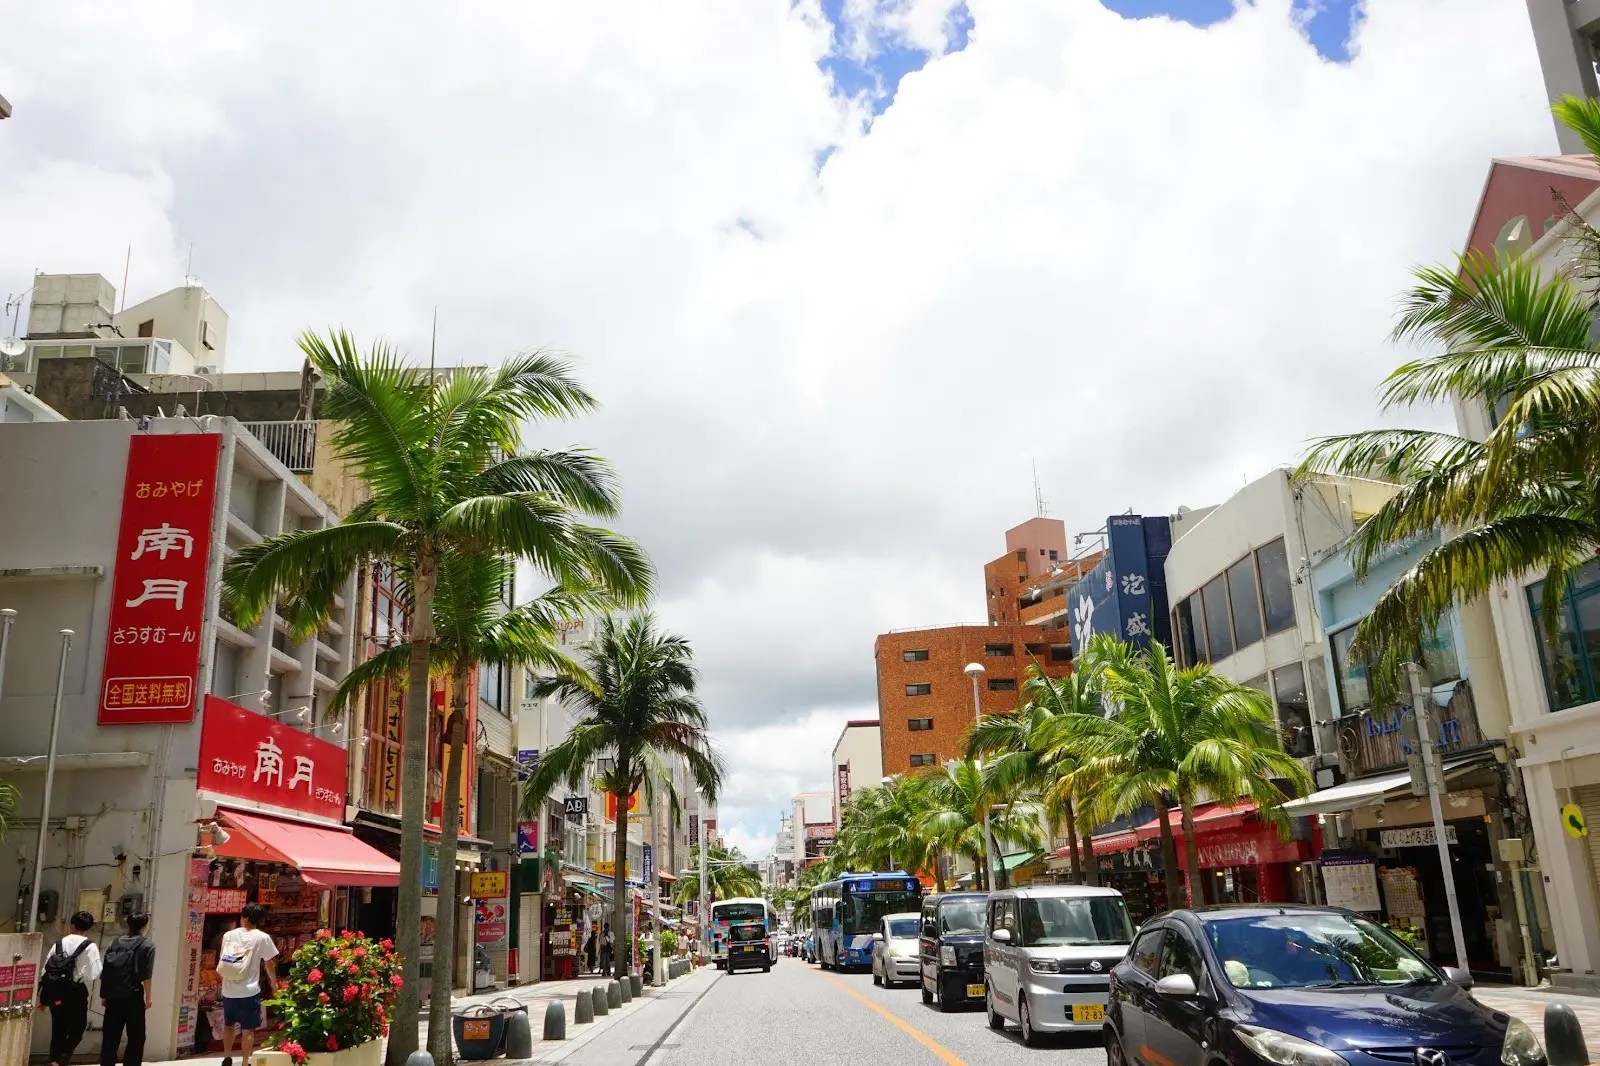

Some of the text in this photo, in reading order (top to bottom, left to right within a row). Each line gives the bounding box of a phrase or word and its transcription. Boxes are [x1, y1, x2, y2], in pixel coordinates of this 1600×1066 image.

[135, 479, 203, 499] おみやげ
[126, 522, 194, 610] 南月
[113, 626, 196, 645] さうすむーん
[108, 682, 189, 706] 全国送料無料
[212, 758, 247, 779] おみやげ
[253, 736, 315, 796] 南月
